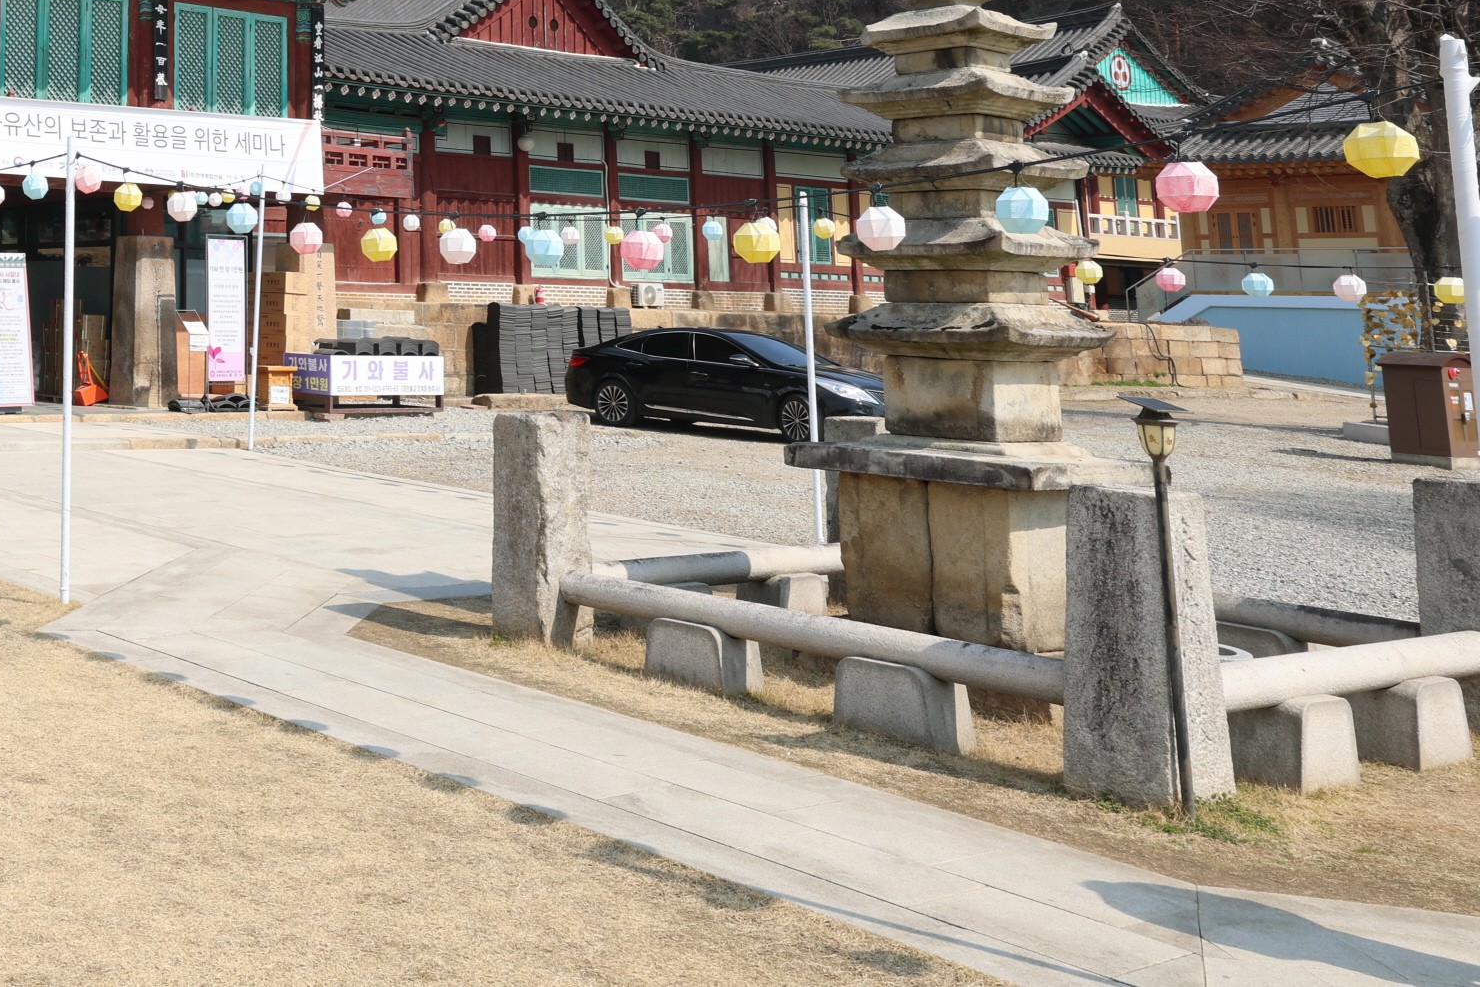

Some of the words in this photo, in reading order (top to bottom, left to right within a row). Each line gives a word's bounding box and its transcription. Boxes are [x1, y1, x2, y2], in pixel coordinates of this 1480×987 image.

[70, 115, 127, 146] 보존과
[132, 121, 188, 151] 활용을
[193, 124, 229, 153] 위한
[235, 129, 286, 158] 세미나
[288, 356, 328, 373] 기와불사
[305, 377, 329, 391] 1만원
